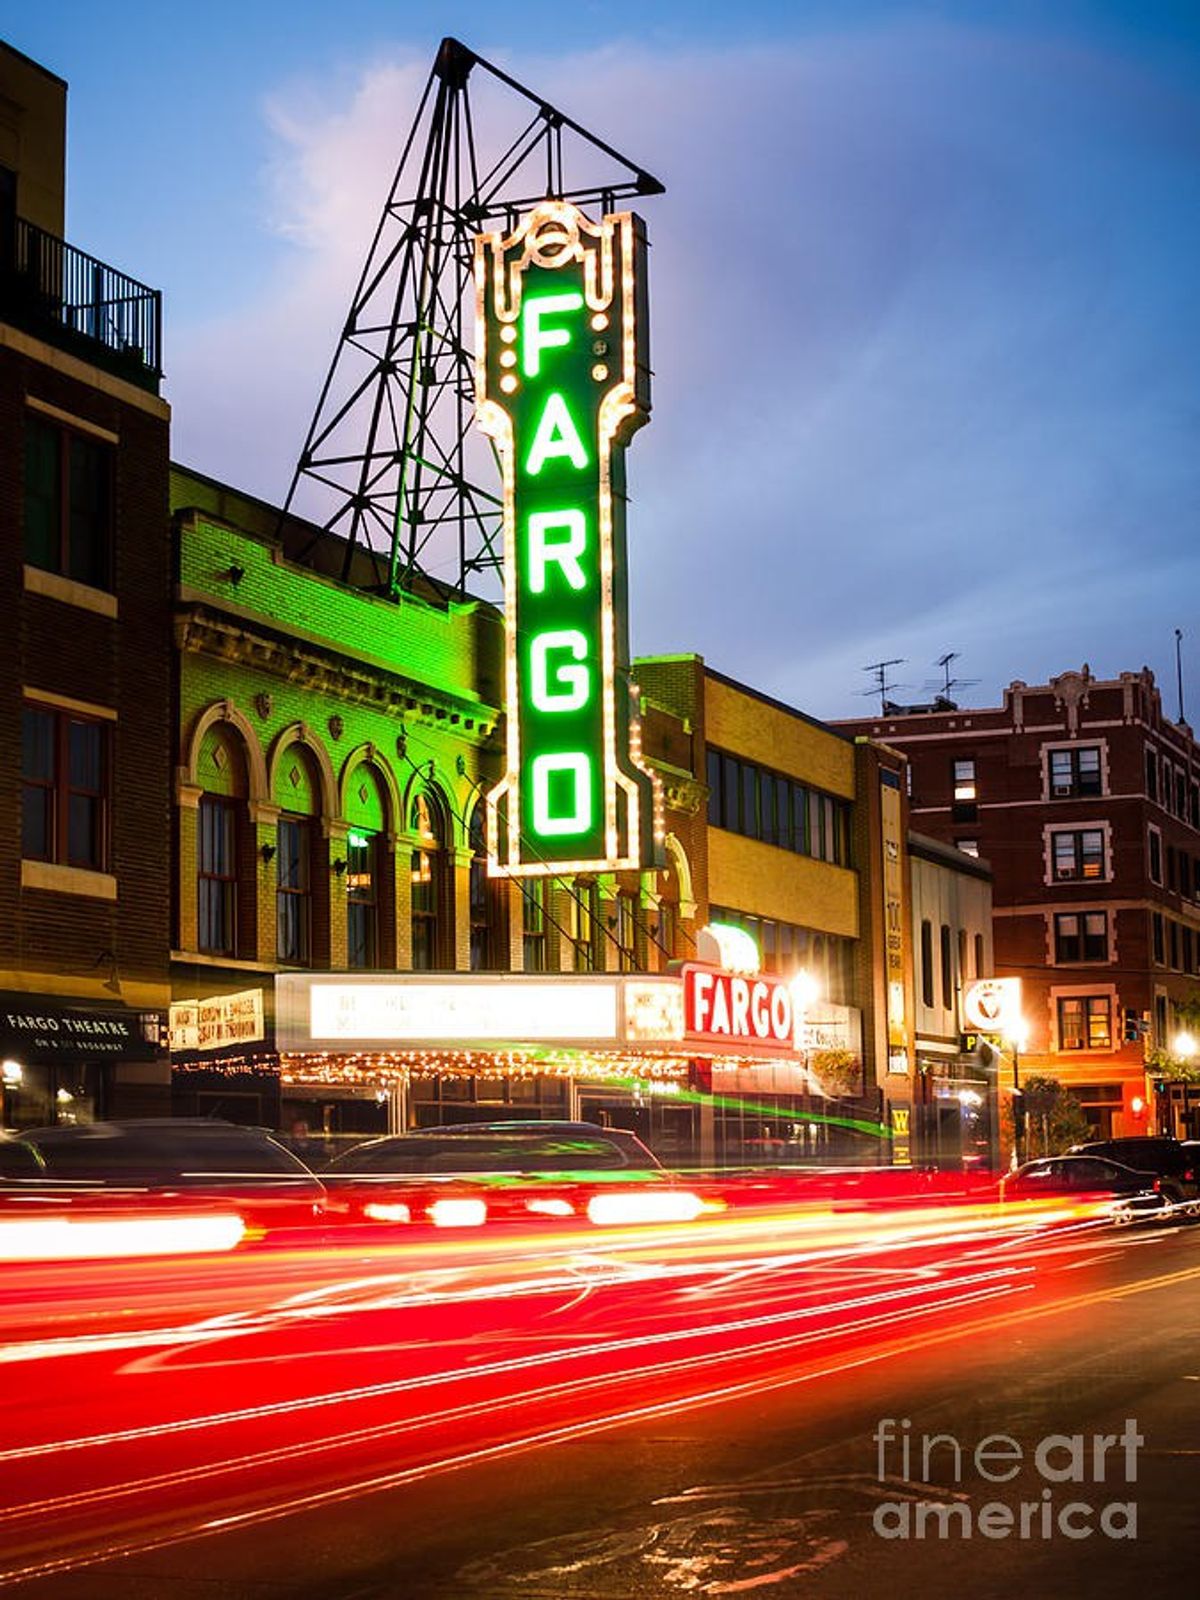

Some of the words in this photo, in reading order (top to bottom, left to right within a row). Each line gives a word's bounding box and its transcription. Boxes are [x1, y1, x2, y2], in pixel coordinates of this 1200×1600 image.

[521, 292, 592, 837] FARGO
[7, 1014, 59, 1031] FARGO
[61, 1018, 129, 1036] THEATRE
[693, 973, 792, 1040] FARGO
